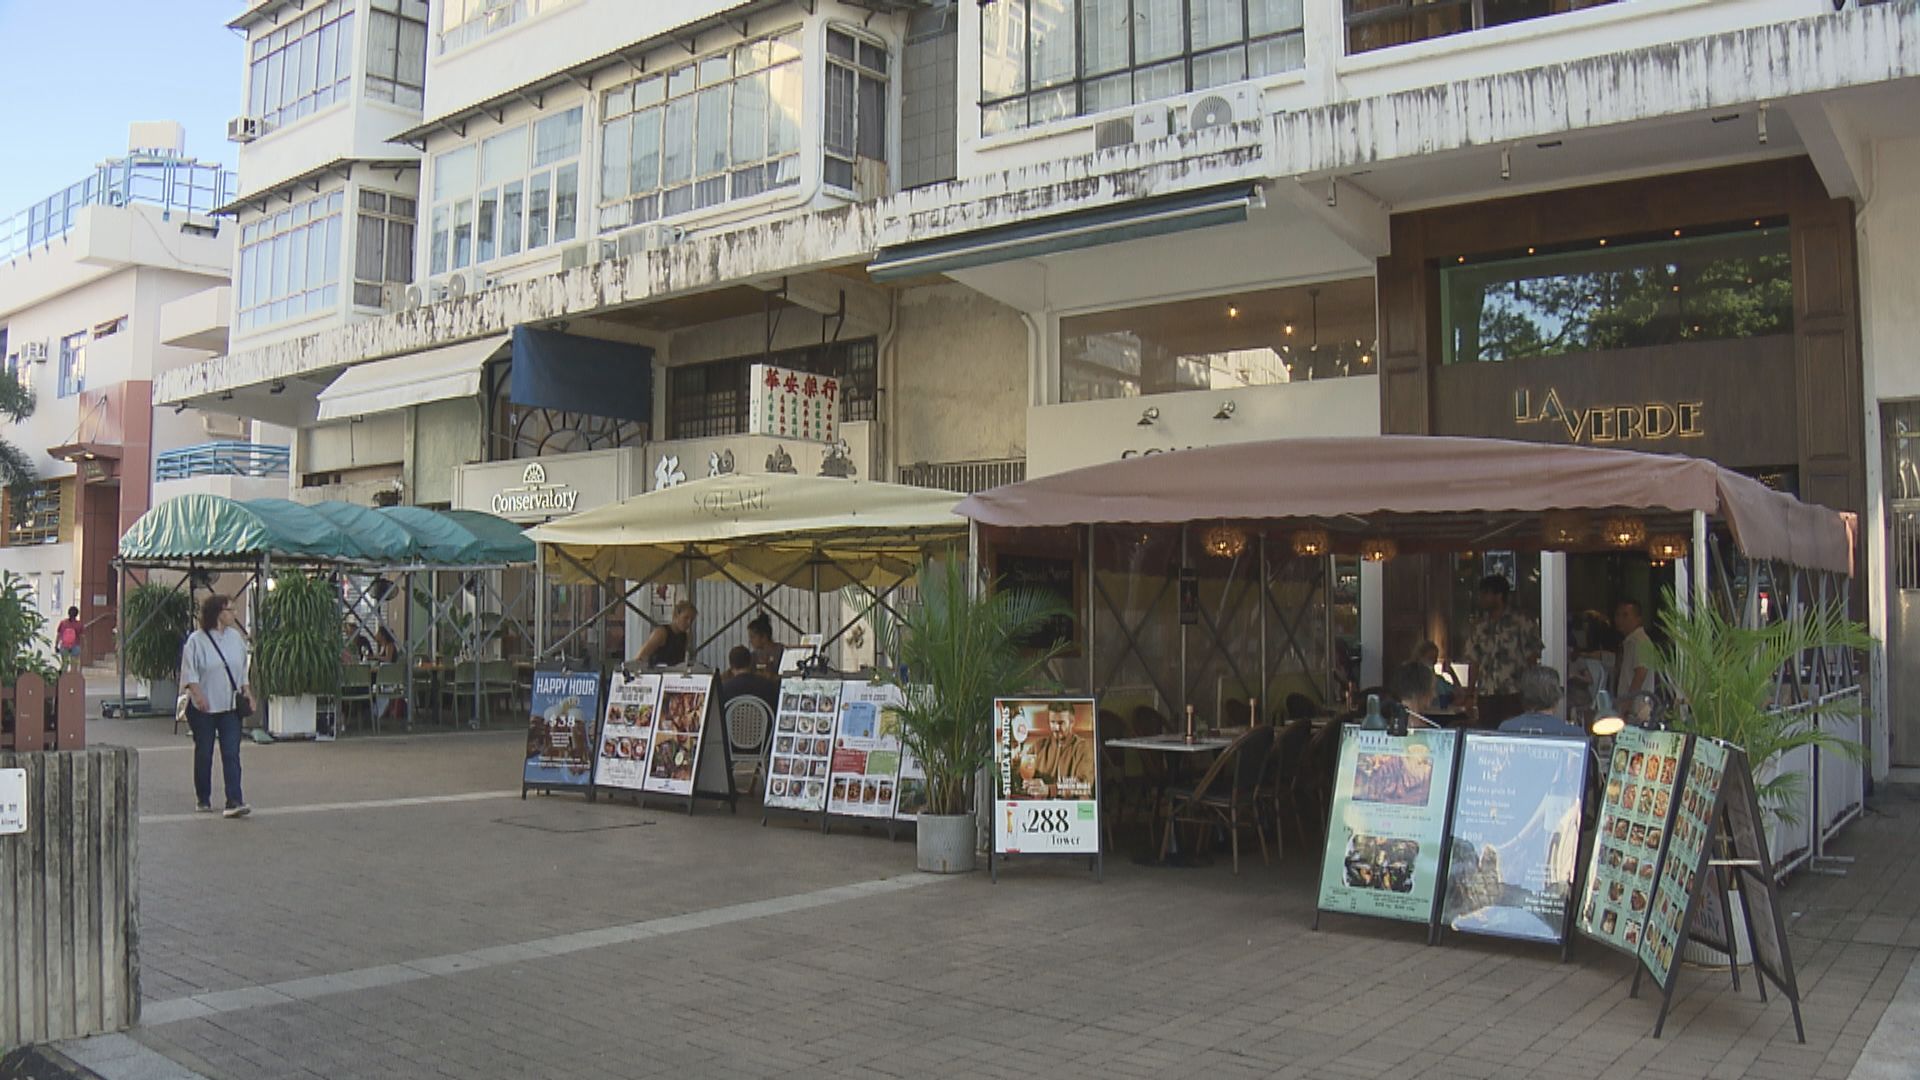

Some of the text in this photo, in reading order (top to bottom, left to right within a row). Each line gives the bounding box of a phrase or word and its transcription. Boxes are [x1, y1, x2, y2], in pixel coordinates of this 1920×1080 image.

[1514, 388, 1705, 443] LA VERDE
[492, 488, 578, 514] Conservatory
[692, 488, 771, 517] SQUARE
[536, 677, 568, 695] HAPPY
[569, 678, 596, 696] HOUR
[1022, 808, 1069, 833] $288
